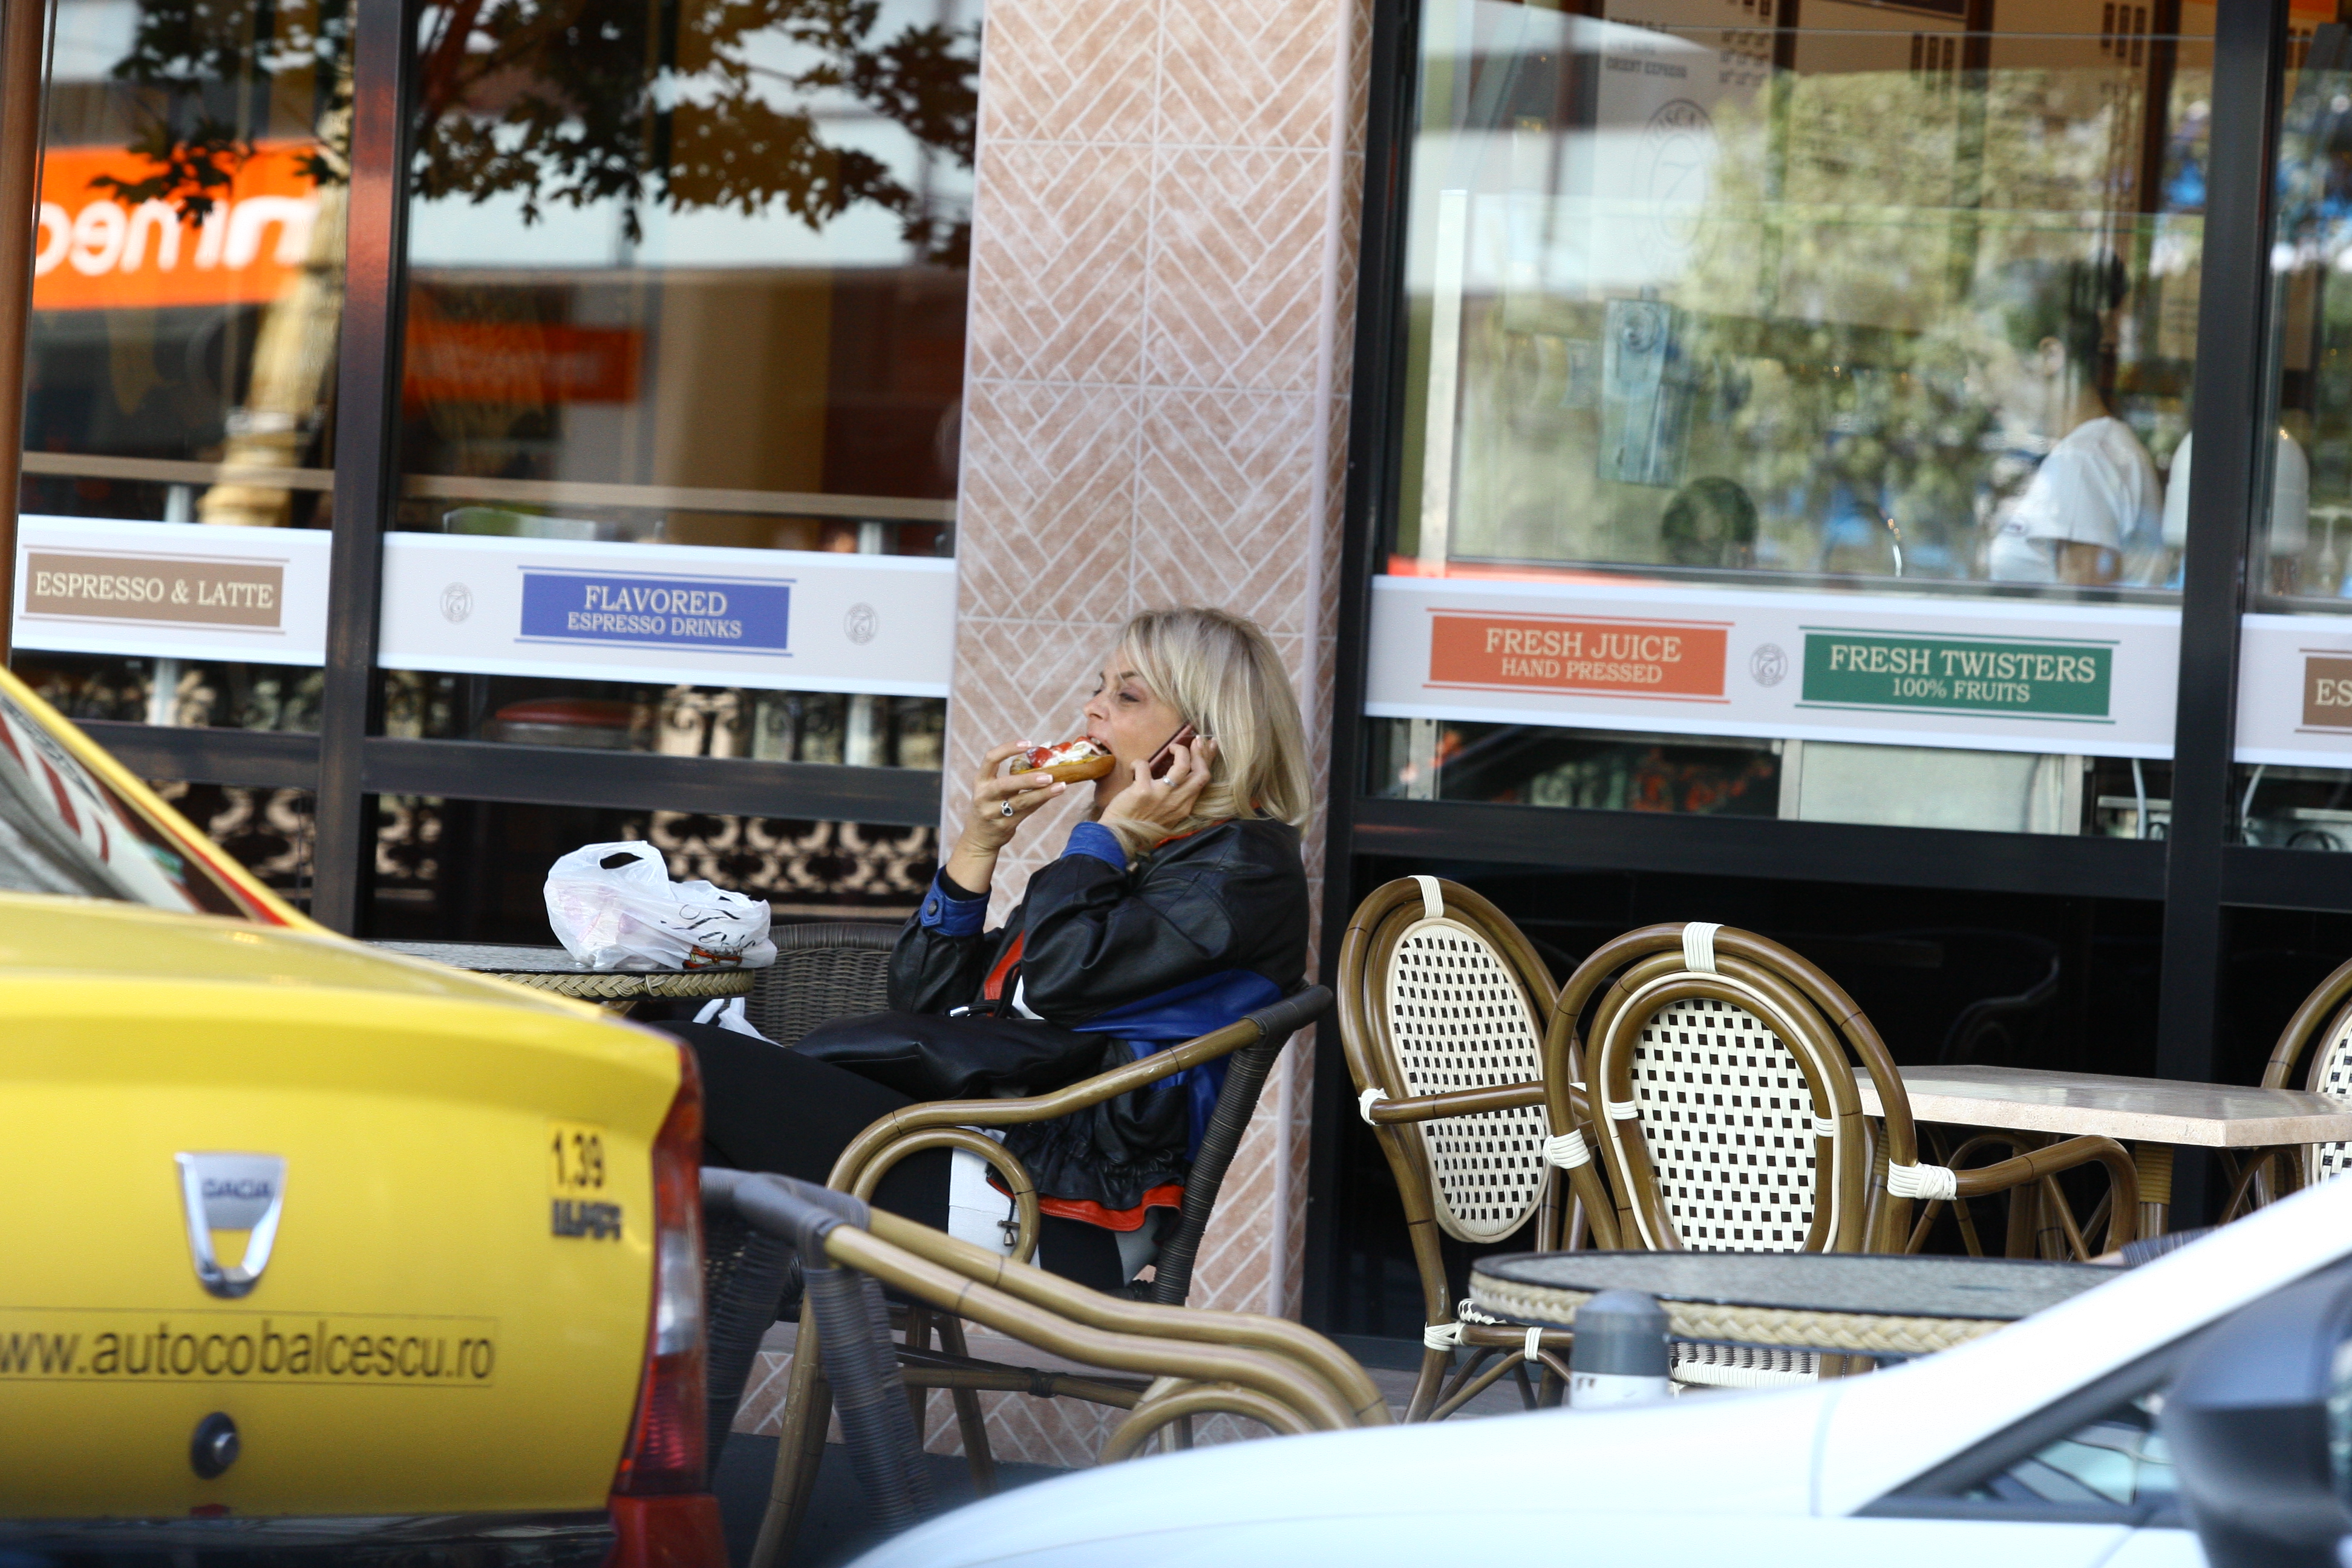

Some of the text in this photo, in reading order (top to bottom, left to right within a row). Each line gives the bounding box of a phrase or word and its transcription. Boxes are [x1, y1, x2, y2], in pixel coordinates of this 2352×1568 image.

[34, 571, 274, 609] ESPRESSO & LATTE
[584, 584, 728, 617] FLAVORED
[567, 611, 743, 639] ESPRESSO DRINKS
[1485, 627, 1682, 663] FRESH JUICE
[1501, 656, 1663, 684] HAND PRESSED
[1829, 644, 1932, 676] FRESH
[1939, 648, 2097, 684] TWISTERS
[1892, 676, 2031, 704] 100% FRUITS
